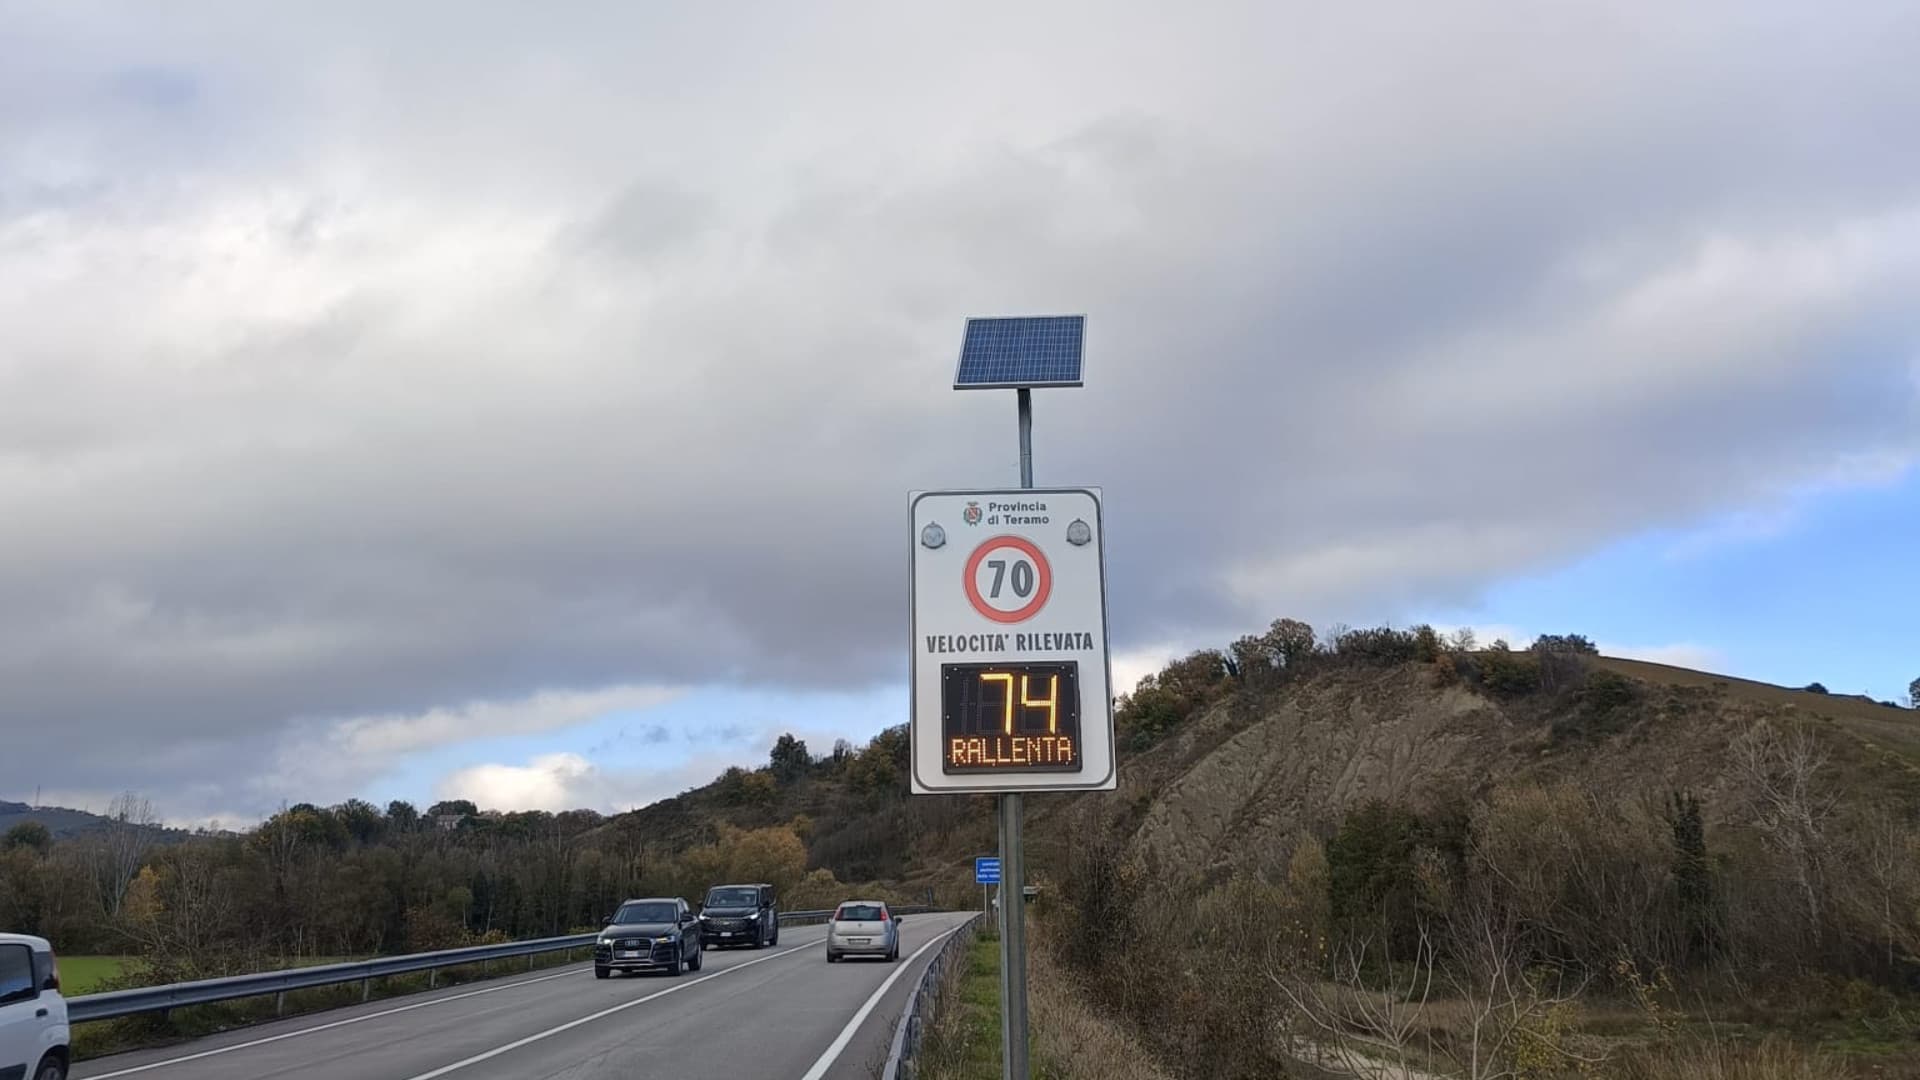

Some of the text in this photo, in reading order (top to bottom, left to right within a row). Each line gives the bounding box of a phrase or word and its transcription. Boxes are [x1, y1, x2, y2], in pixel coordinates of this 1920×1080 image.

[989, 502, 1047, 512] Provincia
[988, 514, 1050, 525] di Teramo
[987, 560, 1034, 598] 70
[926, 632, 1094, 654] VELOCITA' RILEVATA
[980, 673, 1057, 735] 74
[952, 737, 1072, 764] RALLENTA
